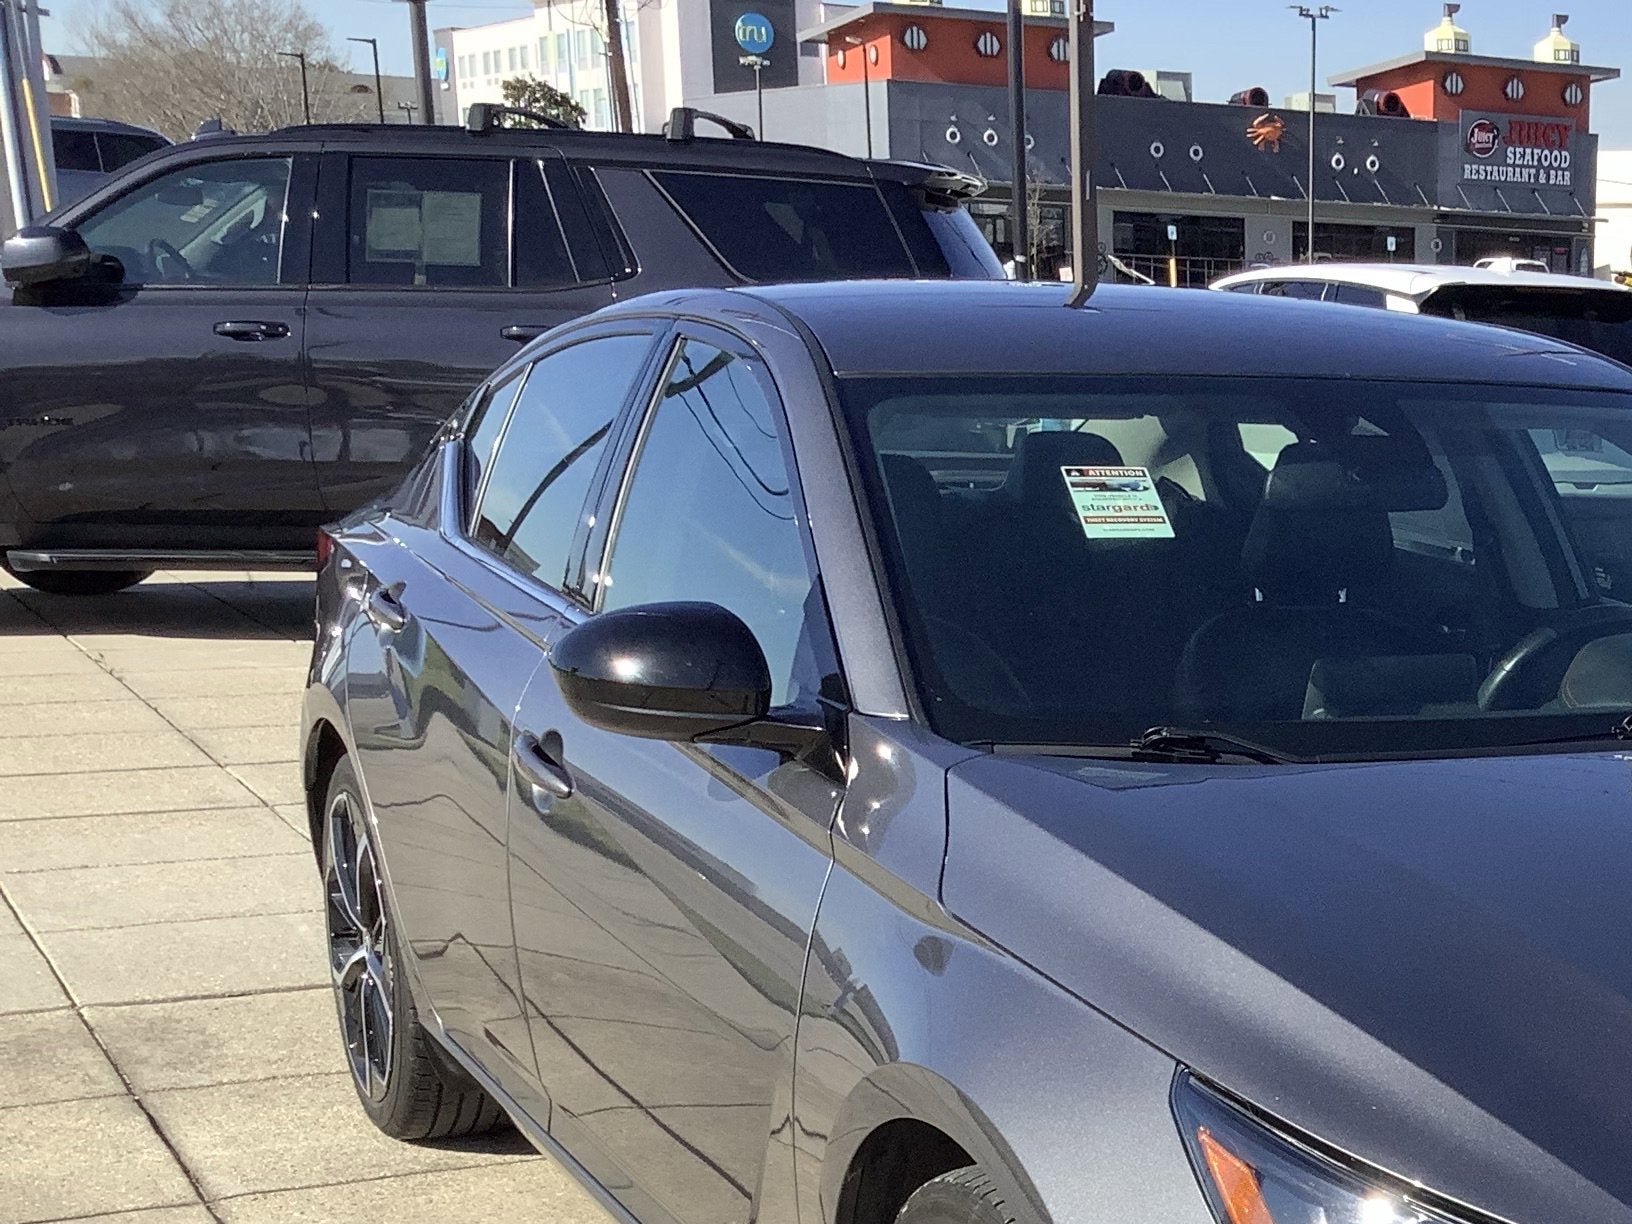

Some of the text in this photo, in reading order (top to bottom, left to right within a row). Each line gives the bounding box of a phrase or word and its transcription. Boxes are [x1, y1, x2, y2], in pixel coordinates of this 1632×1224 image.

[738, 22, 767, 43] tru
[1503, 121, 1569, 148] JUICY
[1506, 146, 1571, 168] SEAFOOD
[1463, 164, 1571, 185] RESTAURANT & BAR
[1081, 503, 1150, 514] stargard
